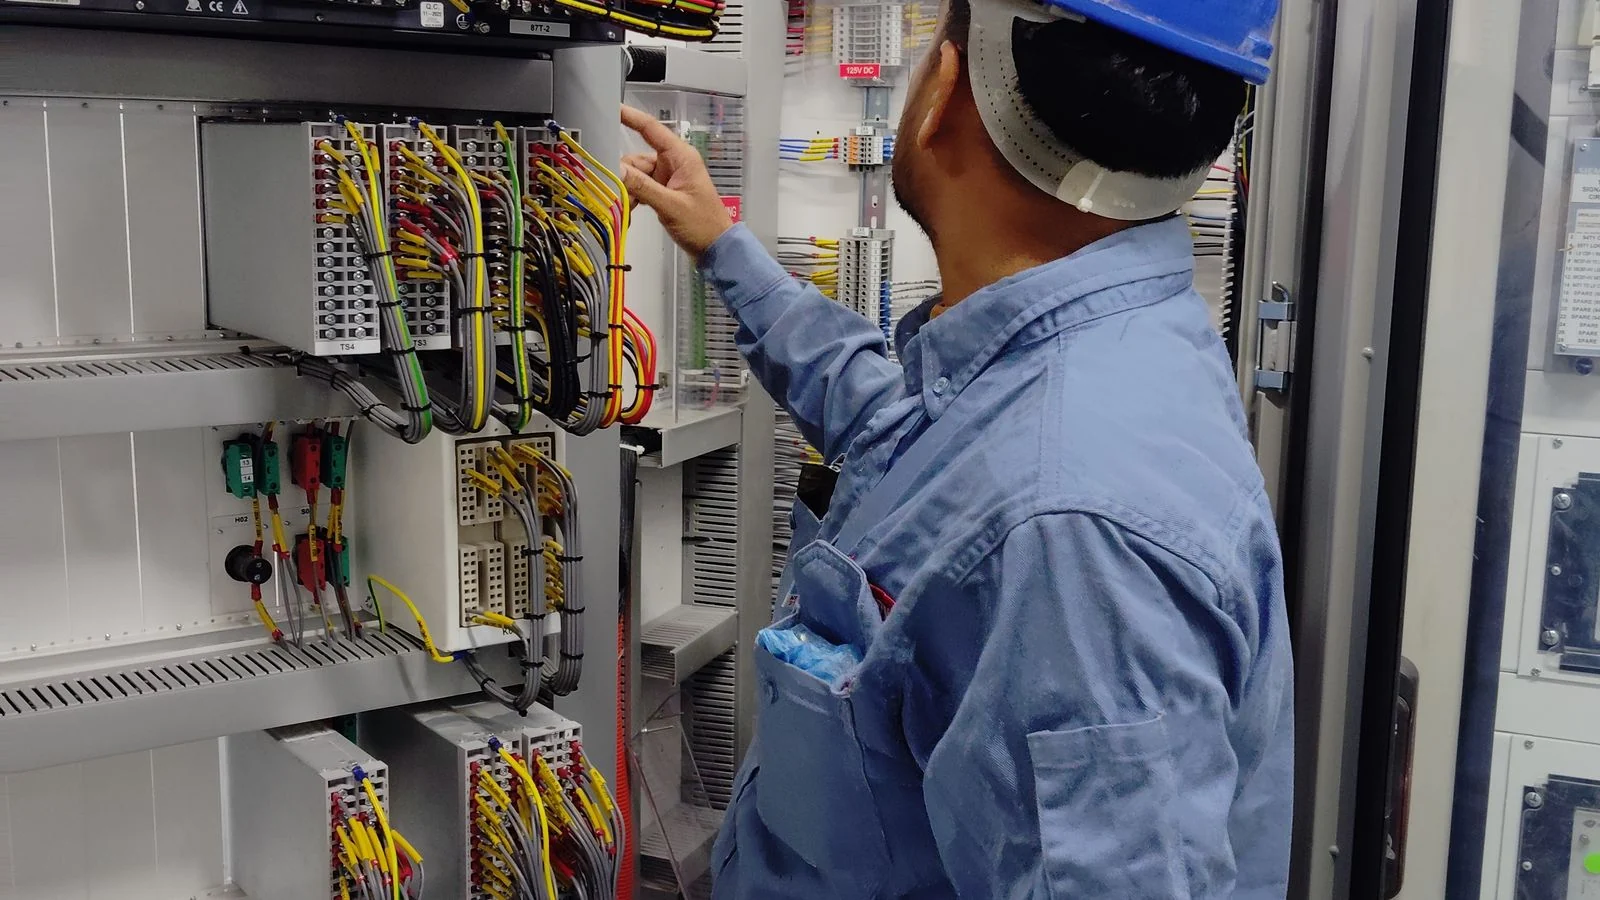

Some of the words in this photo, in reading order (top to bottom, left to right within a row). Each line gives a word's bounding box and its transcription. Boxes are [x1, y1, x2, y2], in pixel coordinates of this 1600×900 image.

[209, 1, 224, 12] CE
[530, 24, 551, 33] 87T-2
[846, 66, 863, 75] 125V
[863, 66, 875, 75] DC
[340, 343, 355, 351] TS4
